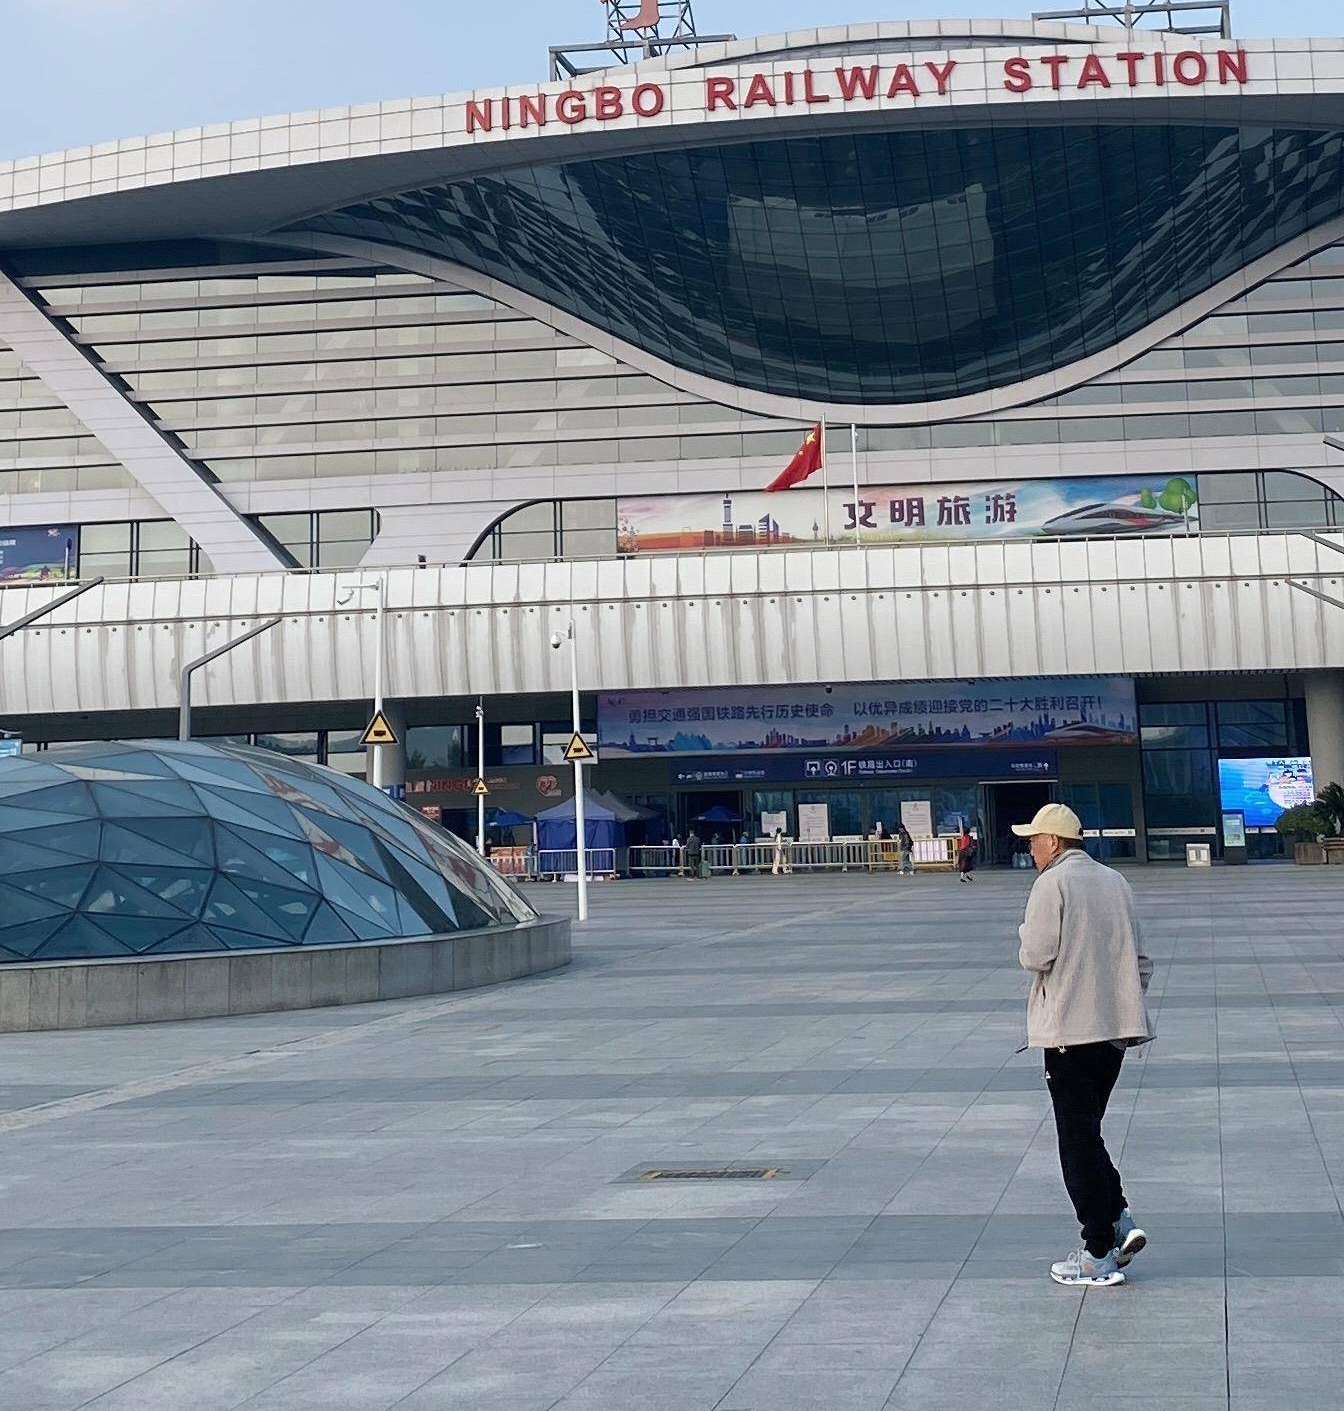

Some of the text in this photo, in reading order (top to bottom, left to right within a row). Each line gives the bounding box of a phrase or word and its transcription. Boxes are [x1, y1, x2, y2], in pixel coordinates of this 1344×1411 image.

[465, 48, 1250, 134] NINGBO RAILWAY STATION
[843, 493, 1017, 530] 文明旅游
[628, 701, 835, 724] 勇担交通强国铁路先行历史使命
